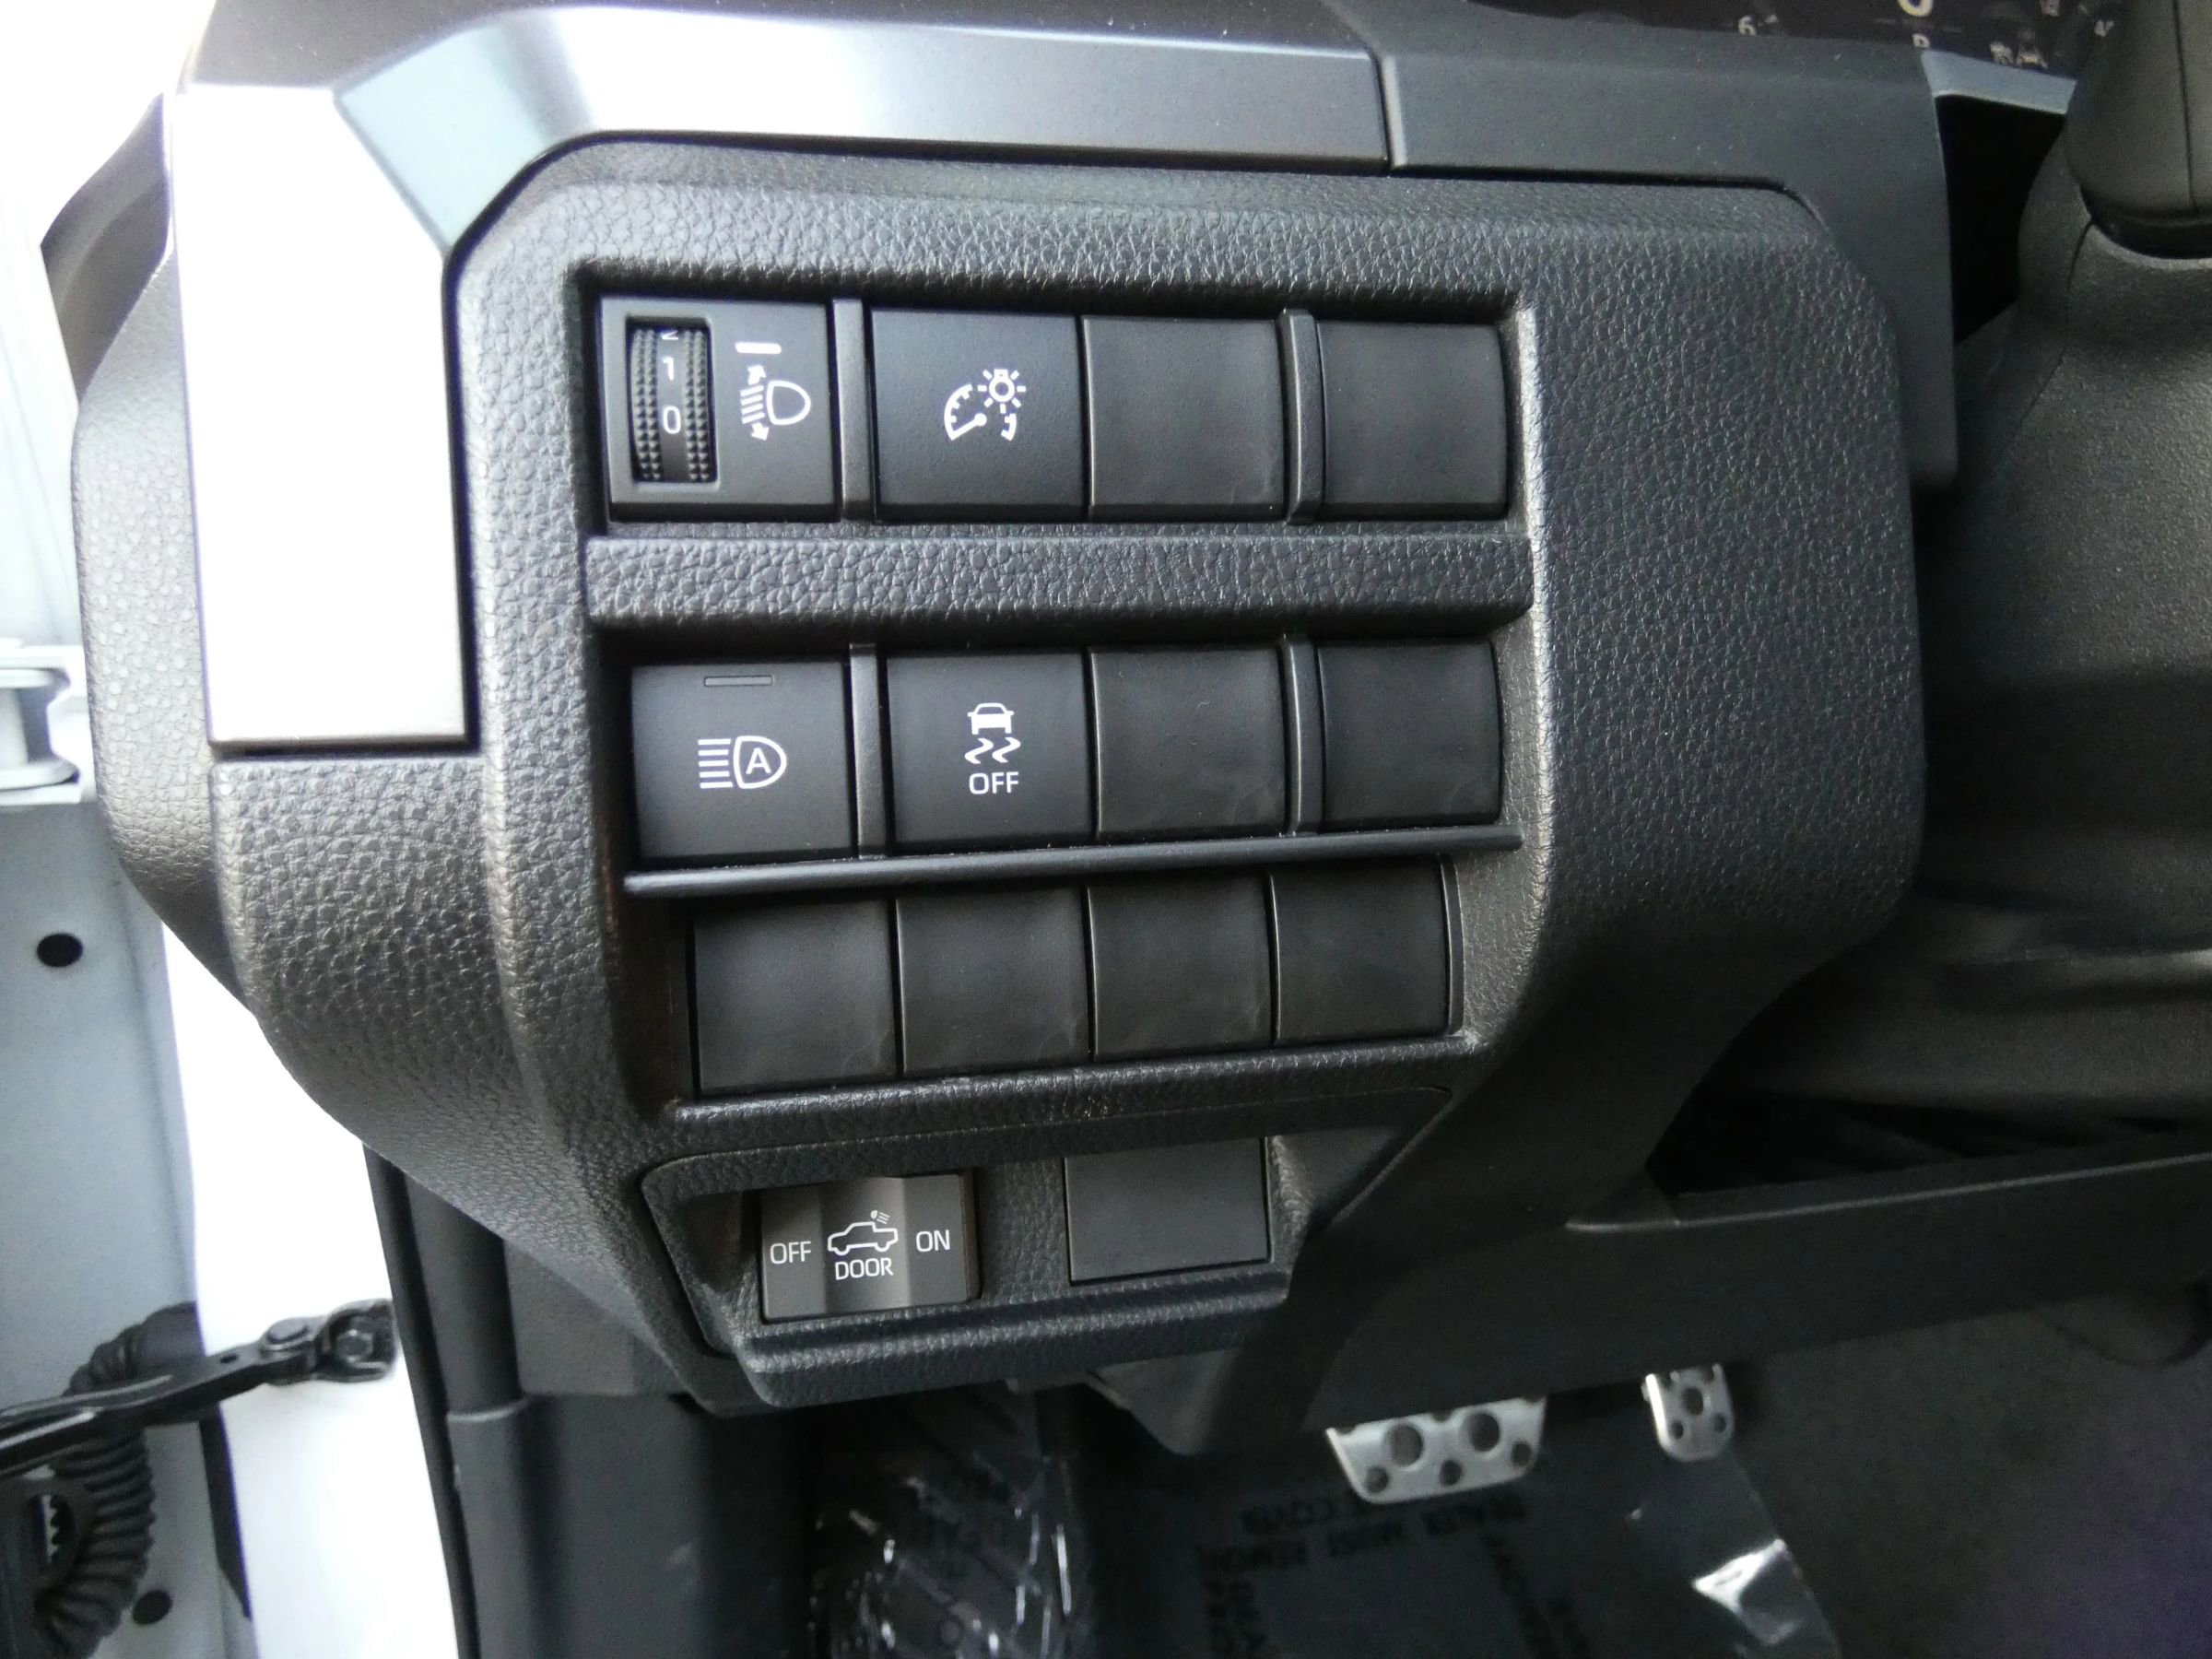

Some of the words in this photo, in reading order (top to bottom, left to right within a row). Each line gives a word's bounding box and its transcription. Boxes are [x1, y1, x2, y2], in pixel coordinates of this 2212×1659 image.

[661, 356, 676, 382] 1
[662, 405, 682, 435] 0
[745, 747, 771, 775] A
[968, 771, 1019, 795] OFF
[770, 1240, 812, 1265] OFF
[914, 1229, 951, 1253] ON
[834, 1257, 894, 1281] DOOR
